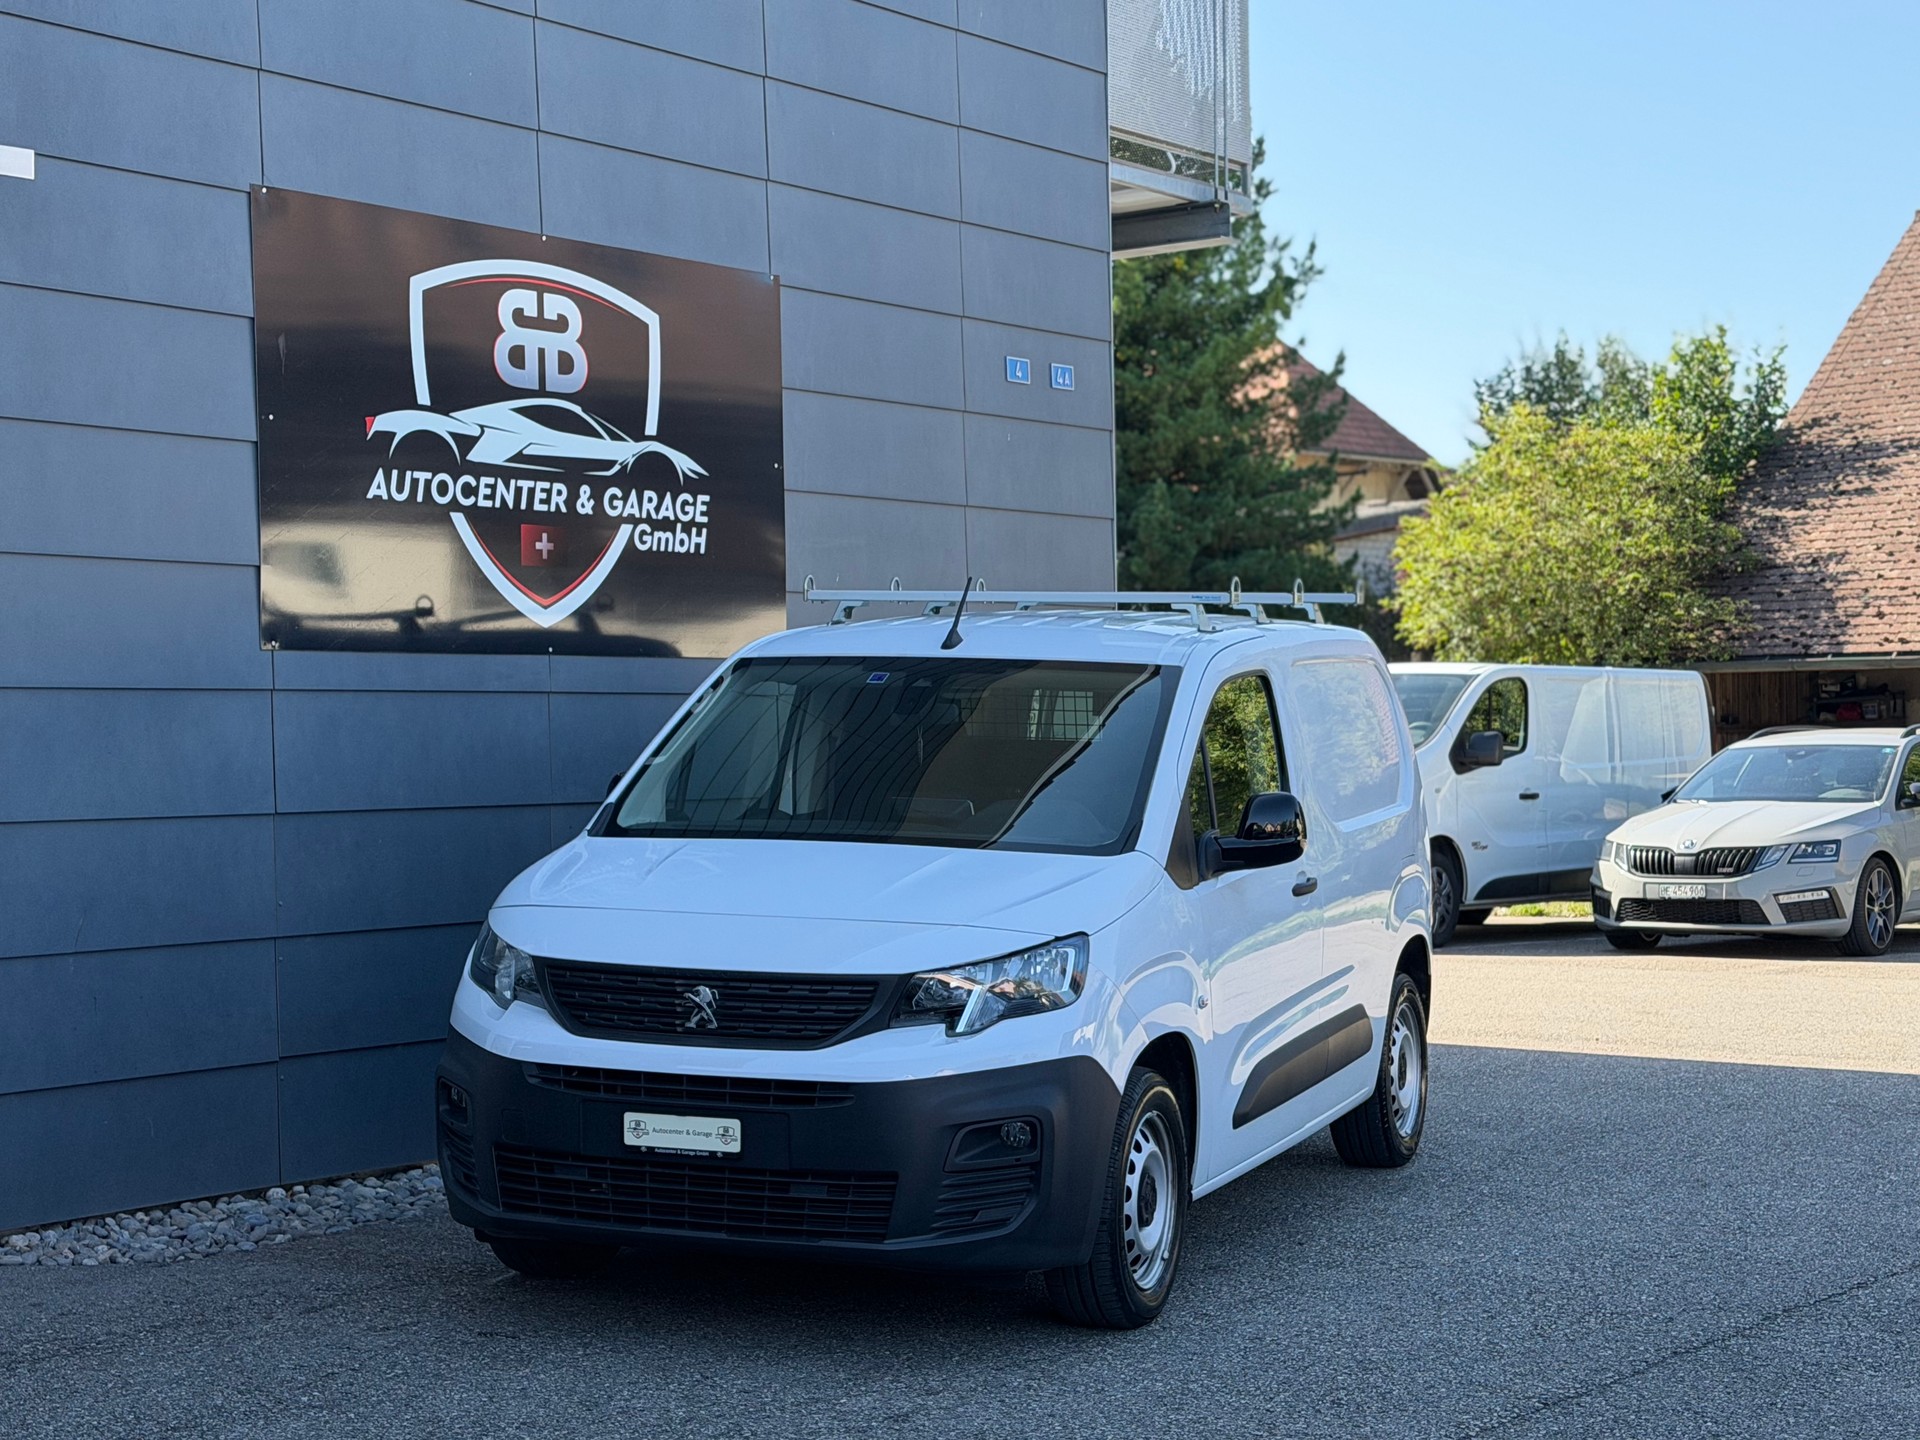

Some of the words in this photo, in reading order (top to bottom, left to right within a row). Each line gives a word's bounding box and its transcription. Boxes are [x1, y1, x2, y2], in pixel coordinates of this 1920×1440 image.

[1015, 361, 1023, 379] 4
[366, 467, 567, 513] AUTOCENTER
[576, 484, 595, 515] &
[603, 486, 710, 523] GARAGE
[634, 523, 707, 554] GmbH
[652, 1127, 685, 1136] Autocenter
[692, 1129, 713, 1139] Garage
